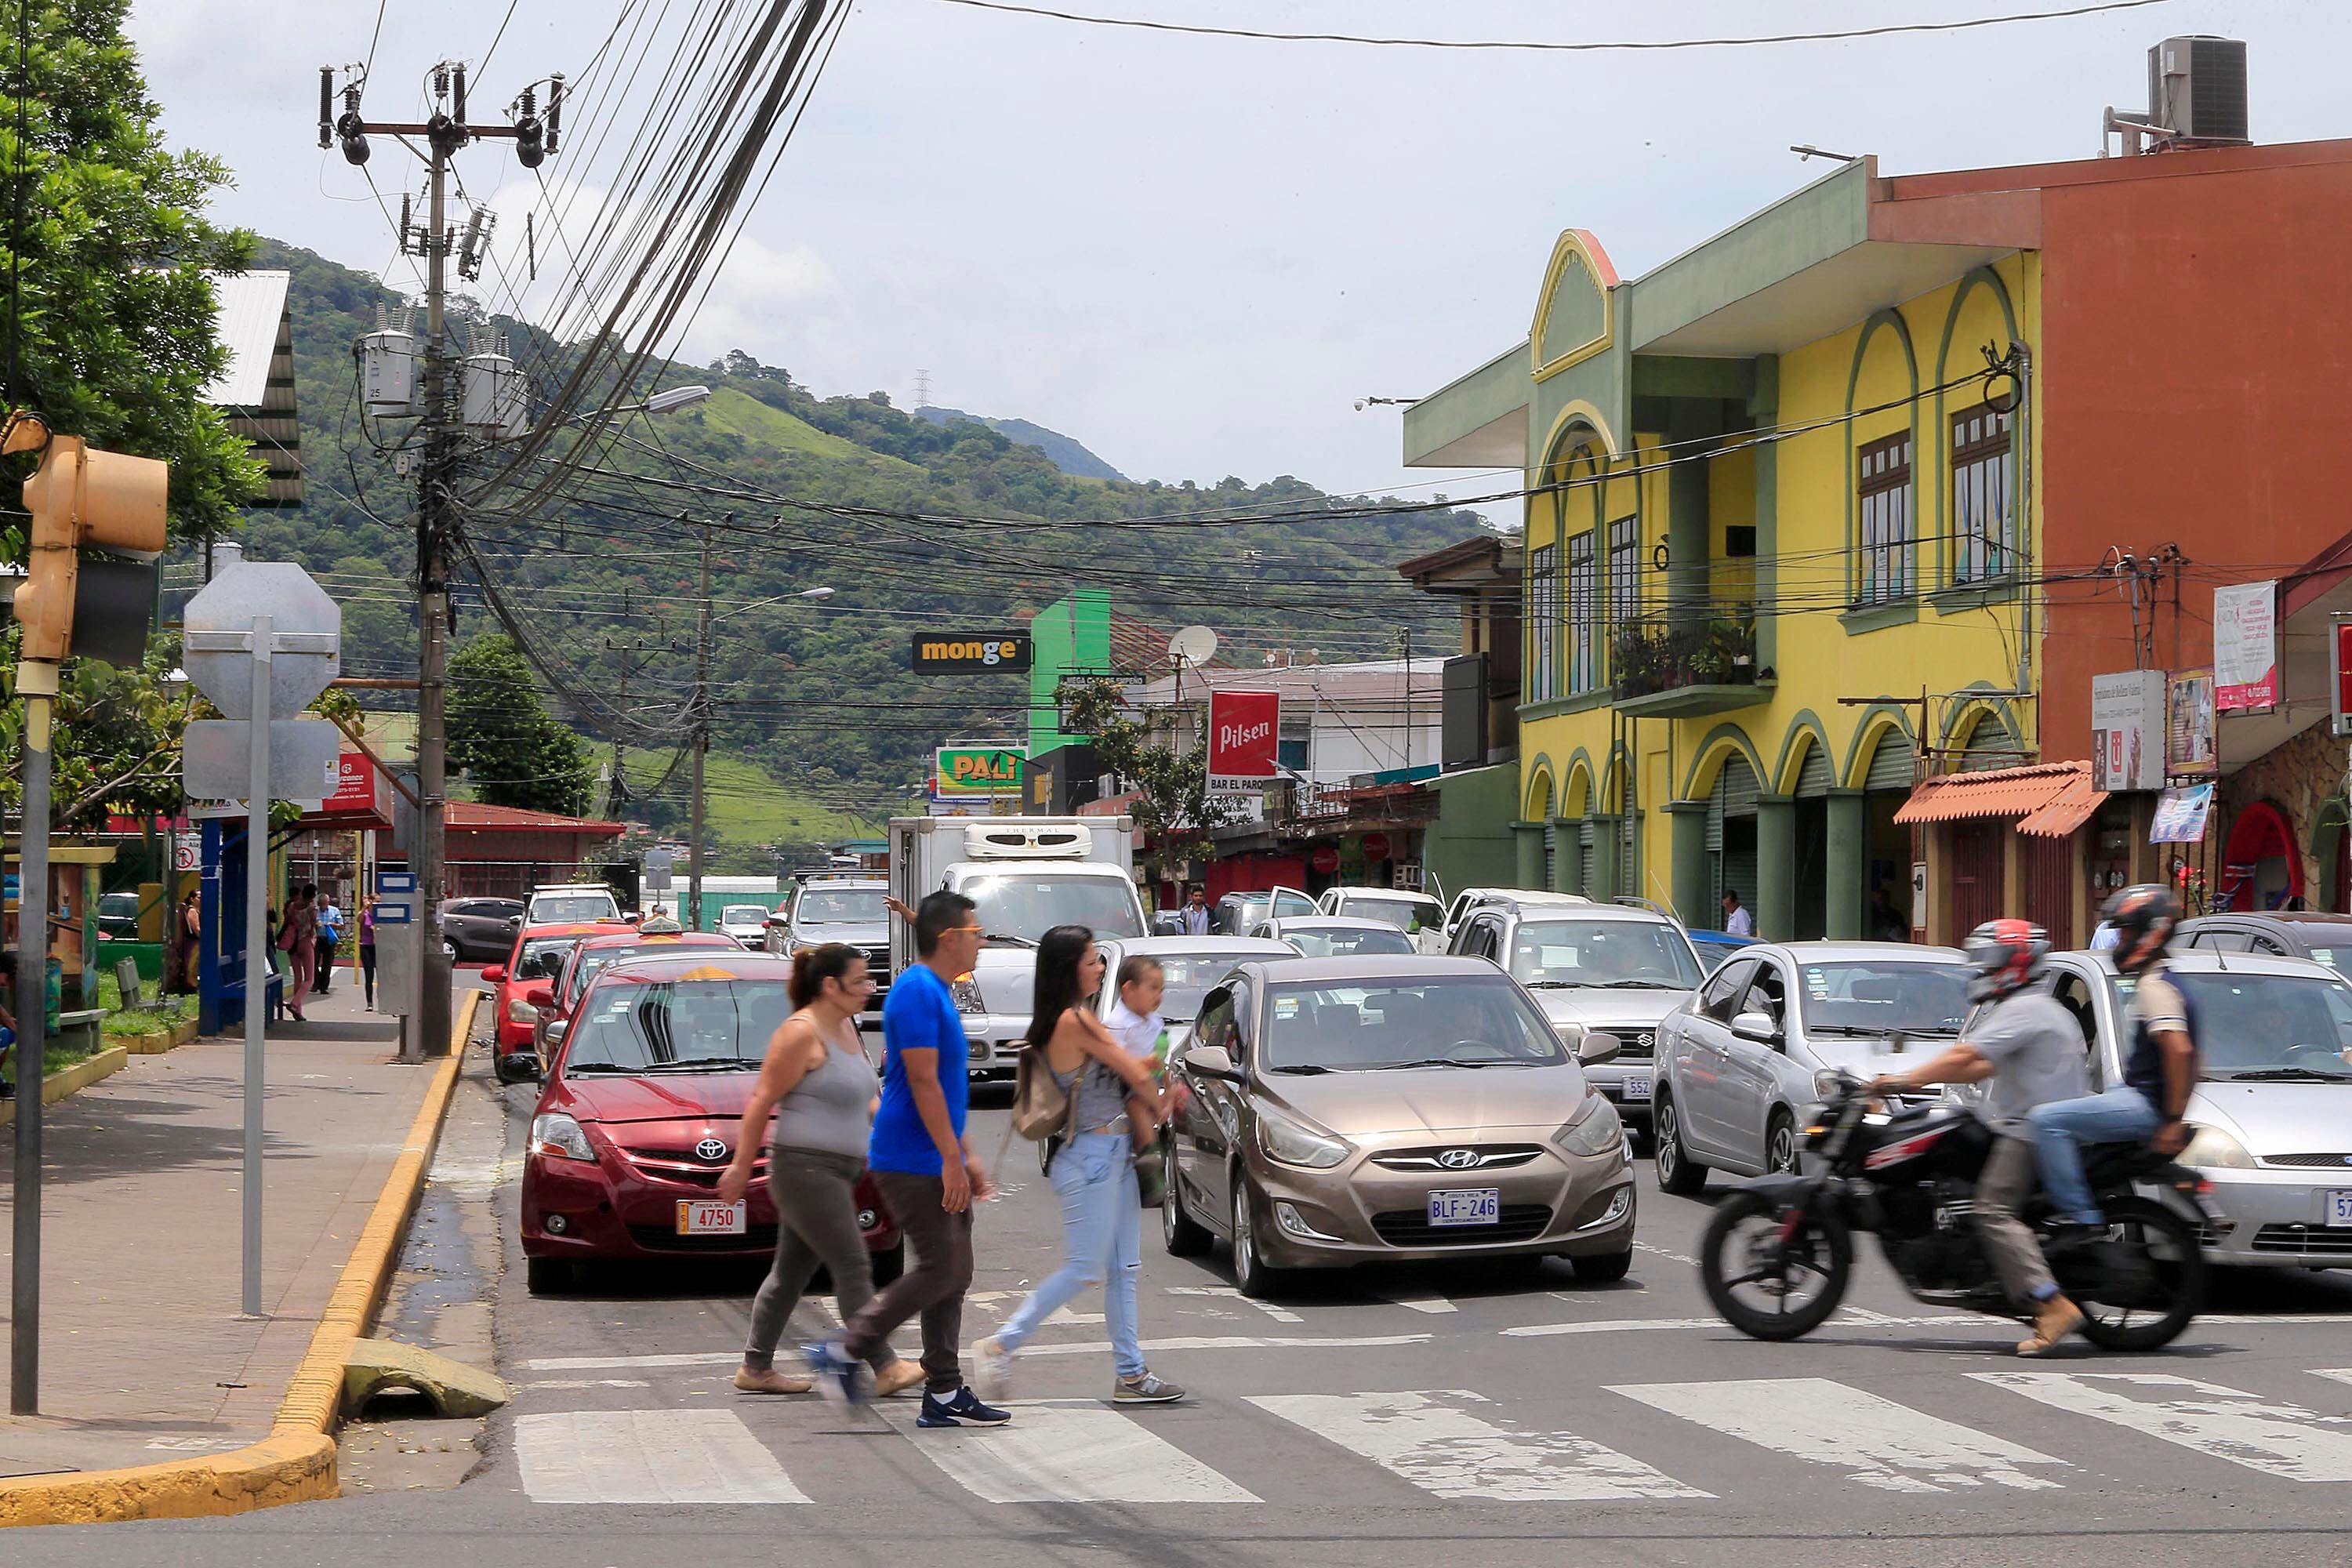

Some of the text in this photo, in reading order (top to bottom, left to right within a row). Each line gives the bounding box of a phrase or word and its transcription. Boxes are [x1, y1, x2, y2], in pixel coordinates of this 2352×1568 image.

[370, 389, 380, 397] 25
[922, 641, 1016, 665] monge
[1220, 721, 1270, 753] Pilsen
[1211, 779, 1264, 789] BAR EL PARQ
[1432, 1199, 1495, 1218] BLF-246
[699, 1210, 734, 1225] 4750
